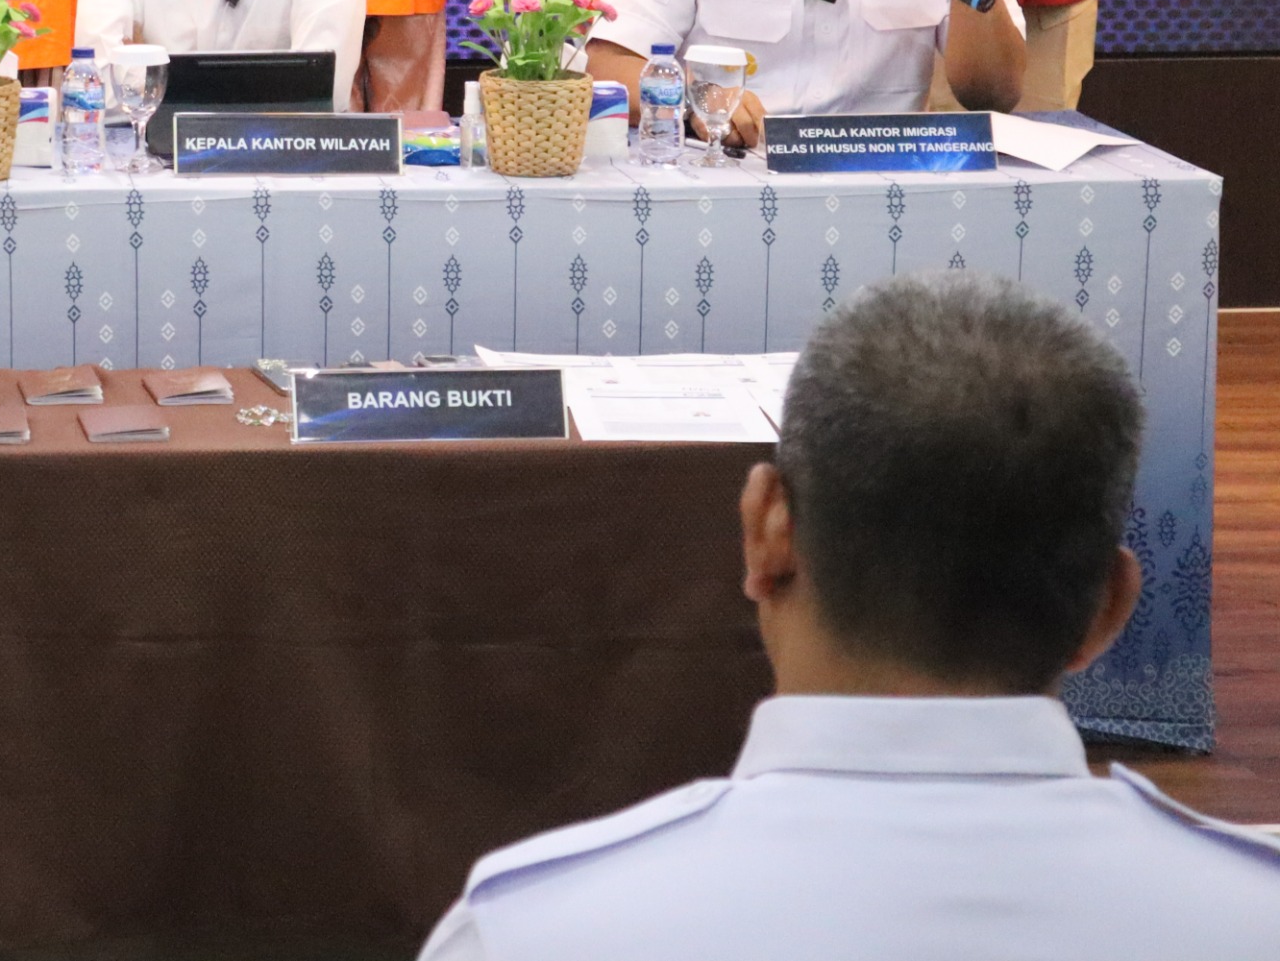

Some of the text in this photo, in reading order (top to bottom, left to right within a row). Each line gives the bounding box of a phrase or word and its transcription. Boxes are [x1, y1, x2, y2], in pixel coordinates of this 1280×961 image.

[799, 126, 957, 138] KEPALA KANTOR IMIGRASI
[185, 137, 391, 152] KEPALA KANTOR WILAYAH
[767, 143, 806, 155] KELAS
[816, 143, 866, 154] KHUSUS
[869, 143, 894, 154] NON
[897, 143, 917, 154] TPI
[919, 142, 994, 153] TANGERANG
[347, 389, 513, 410] BARANG BUKTI
